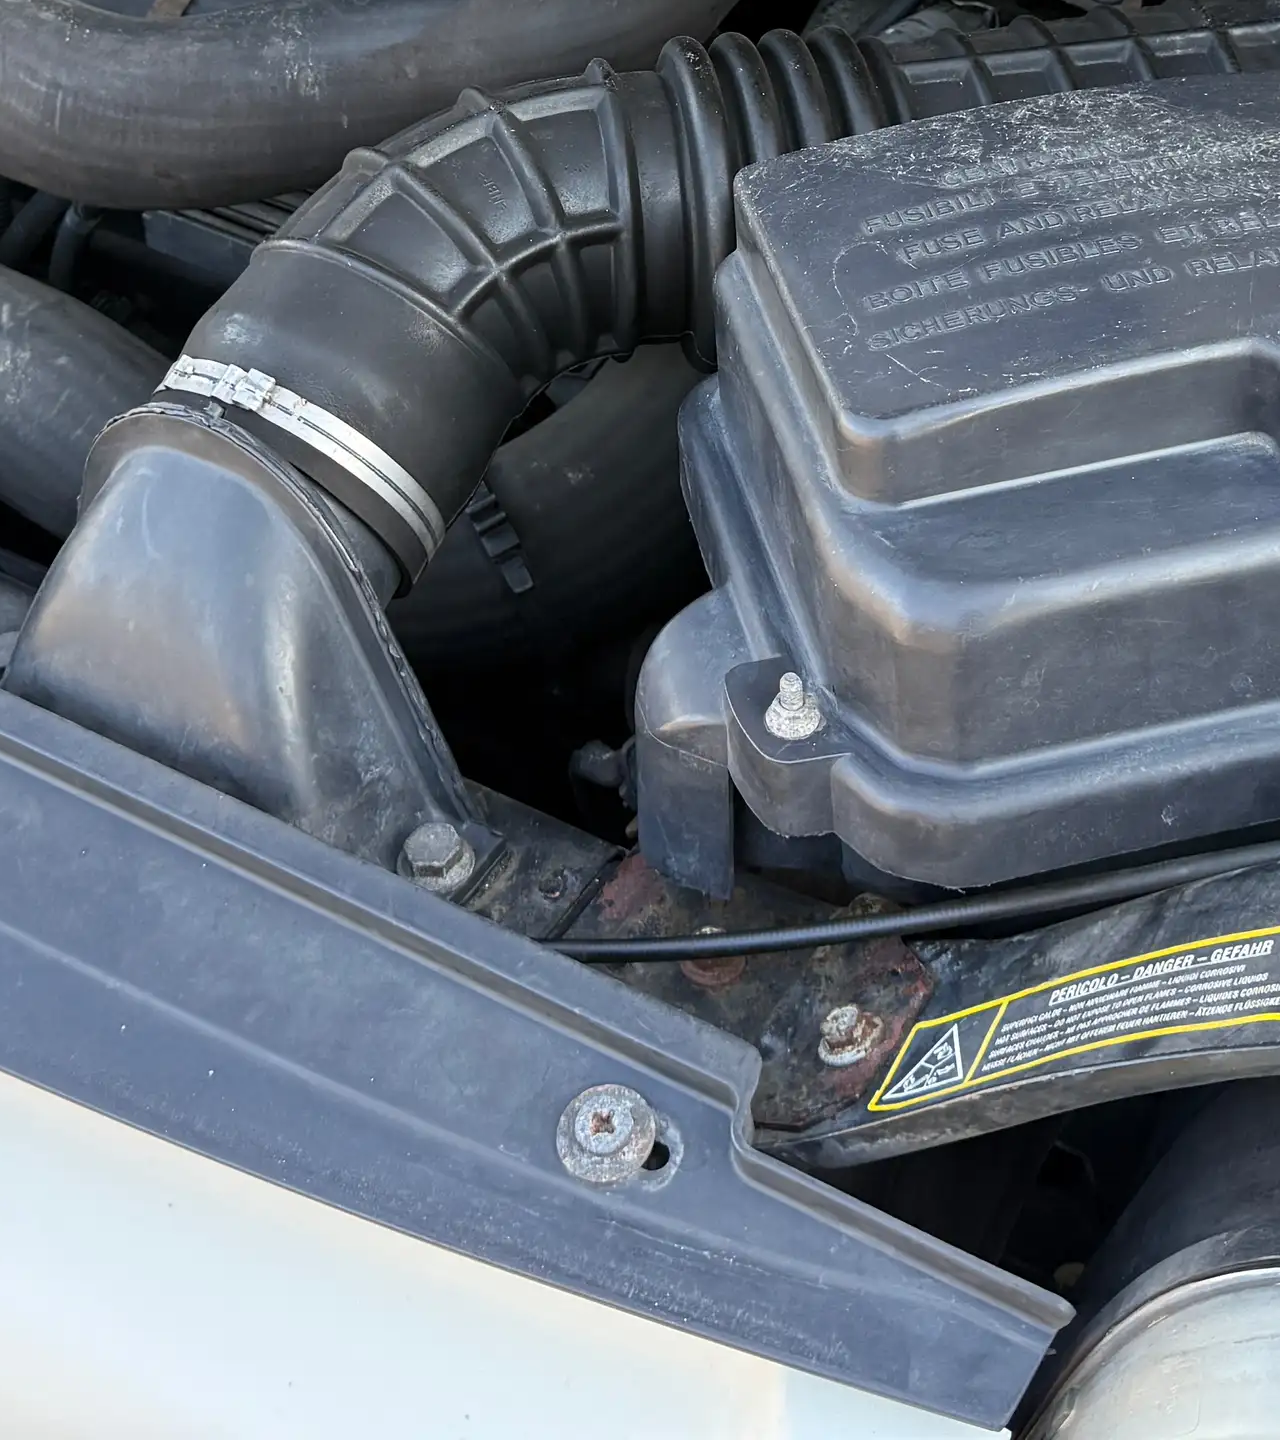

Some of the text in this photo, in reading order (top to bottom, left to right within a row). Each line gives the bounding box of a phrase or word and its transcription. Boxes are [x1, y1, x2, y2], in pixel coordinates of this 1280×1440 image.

[863, 188, 996, 234] FUSIBILI
[902, 227, 987, 262] FUSE
[998, 210, 1065, 240] AND
[1073, 190, 1170, 223] RELAY
[867, 269, 970, 312] BOITE
[980, 232, 1144, 281] FUSIBLES
[1158, 223, 1198, 245] ET
[868, 284, 1089, 351] SICHERUNGS-
[1101, 266, 1172, 292] UND
[1049, 973, 1118, 1006] PERICOLO
[1132, 954, 1195, 981] DANGER
[1210, 939, 1274, 965] GEFAHR
[1167, 971, 1199, 985] LIQUIDI
[1199, 964, 1246, 979] CORROSIVI
[988, 1041, 1024, 1059] SURFACES
[1065, 1025, 1076, 1034] NE
[1076, 1020, 1092, 1031] PAS
[1091, 1008, 1138, 1026] APPROCHER
[1139, 1005, 1150, 1014] DE
[1151, 996, 1192, 1011] FLAMMES
[1198, 989, 1239, 1004] LIQUIDES
[994, 1035, 1010, 1046] HOT
[1010, 1023, 1048, 1041] SURFACES
[1054, 1018, 1065, 1028] DO
[1066, 1013, 1081, 1024] NOT
[1081, 1004, 1111, 1019] EXPOSE
[1111, 1000, 1122, 1010] TO
[1122, 995, 1144, 1007] OPEN
[1144, 987, 1177, 1001] FLAMES
[1184, 978, 1233, 994] CORROSIVE
[1233, 972, 1269, 986] LIQUIDS
[1044, 1038, 1066, 1052] NICHT
[1065, 1033, 1081, 1044] MIT
[1081, 1023, 1116, 1040] OFFENEM
[1116, 1018, 1143, 1031] FEUER
[1142, 1010, 1189, 1025] HANTIEREN
[1194, 1003, 1234, 1017] ÄTZENDE
